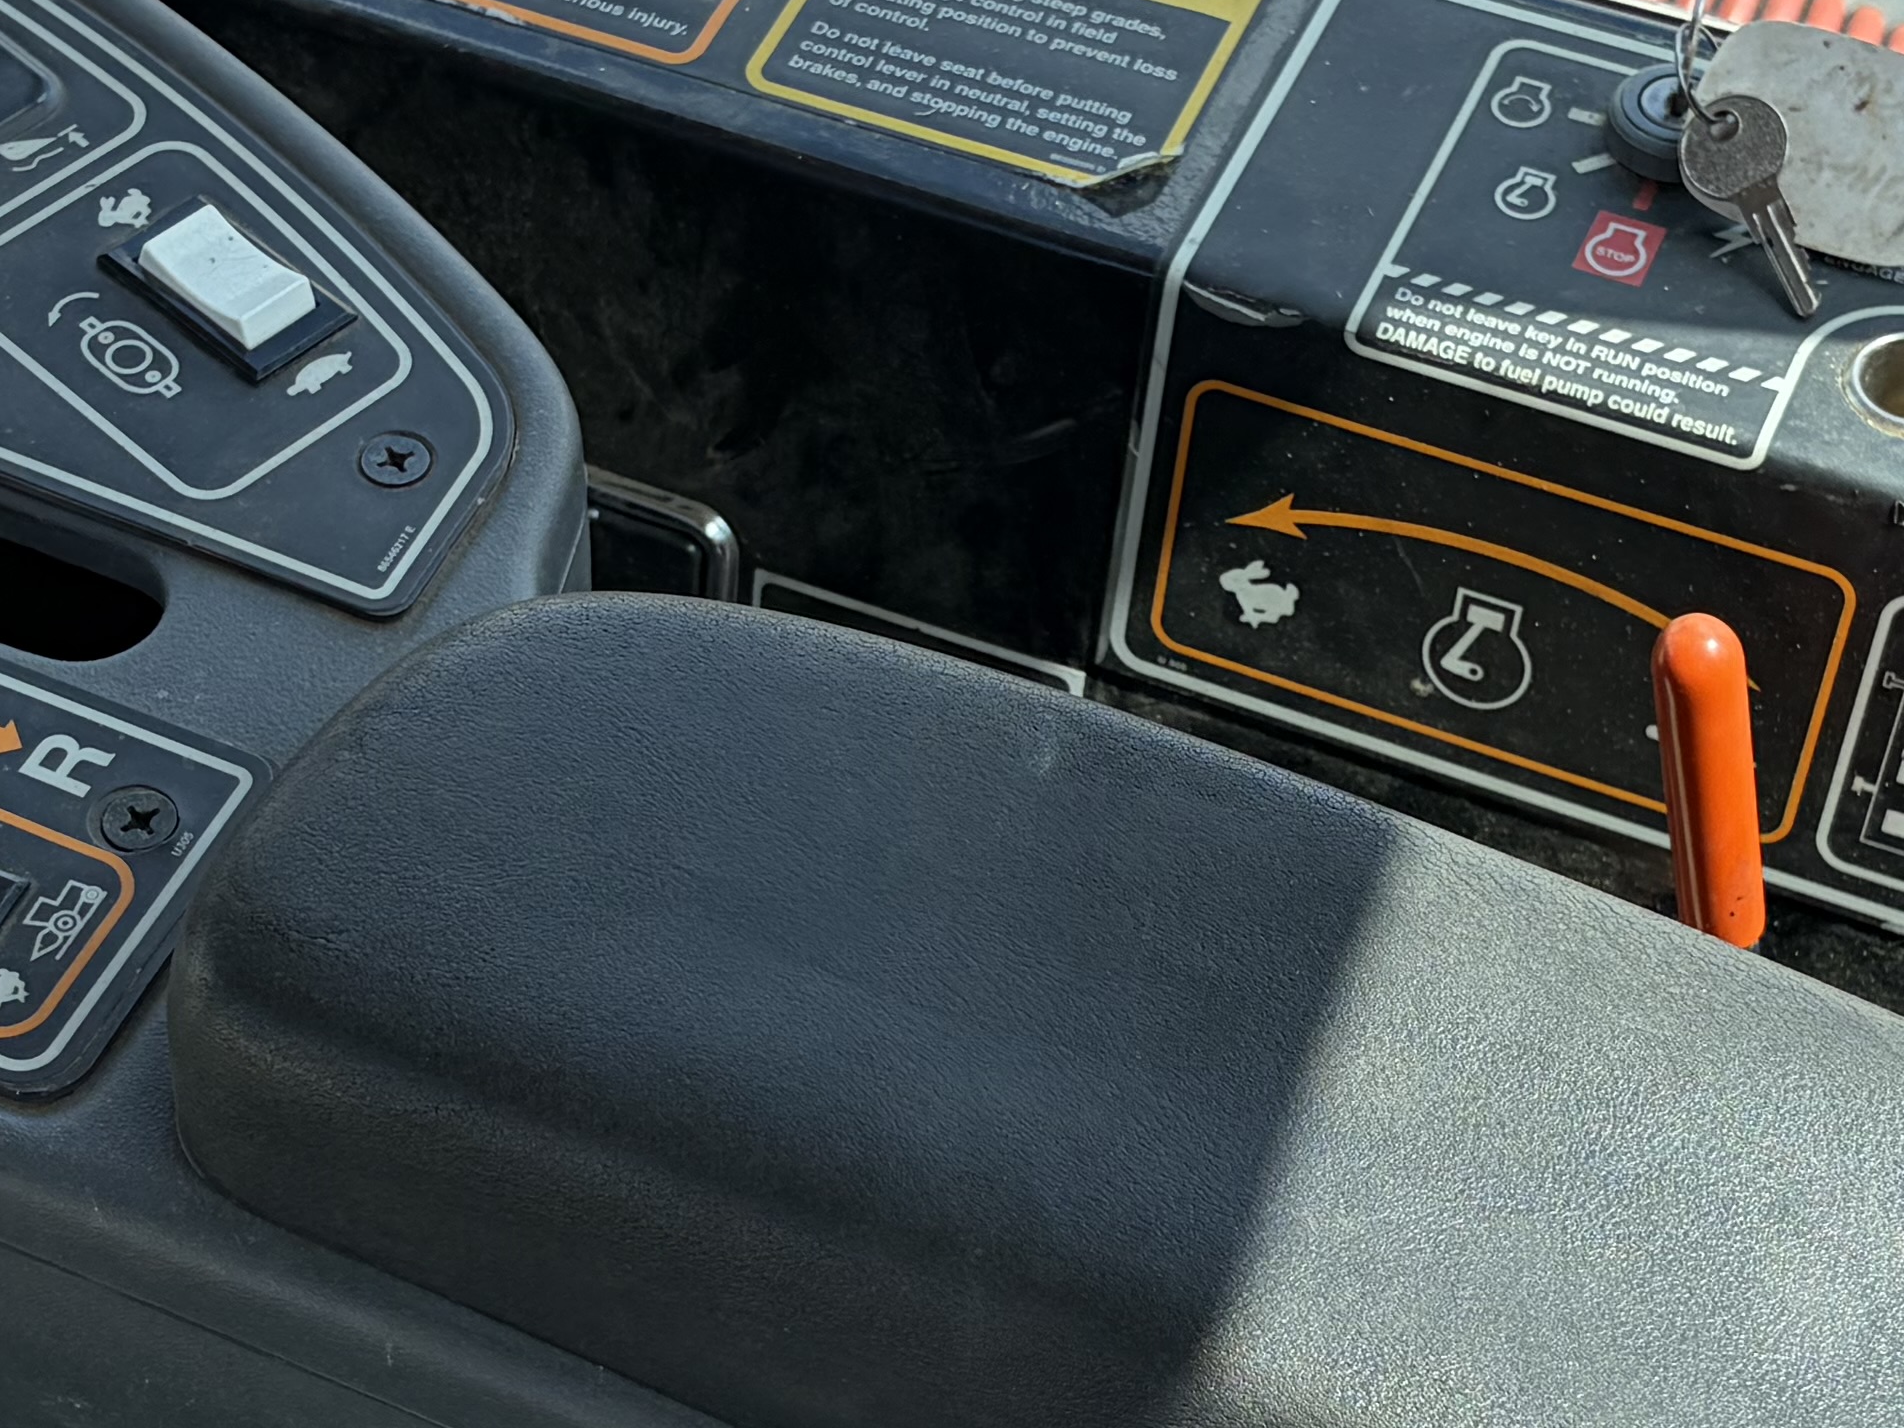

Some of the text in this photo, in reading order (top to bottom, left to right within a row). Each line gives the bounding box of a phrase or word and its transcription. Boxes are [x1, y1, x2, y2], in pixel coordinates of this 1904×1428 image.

[627, 7, 687, 36] injury.
[854, 2, 929, 32] control.
[936, 6, 1022, 37] position
[1025, 29, 1048, 44] to
[1049, 38, 1131, 68] prevent
[1133, 59, 1178, 81] loss
[1046, 15, 1067, 30] in
[1070, 22, 1118, 44] field
[1090, 10, 1166, 41] grades,
[788, 54, 1118, 160] brakes, and stopping the engine.
[800, 40, 1147, 147] control lever in neutral, setting the
[810, 21, 1132, 125] Do not leave seat before putting
[1596, 246, 1635, 263] STOP
[1386, 305, 1679, 405] when engine is NOT running.
[1395, 286, 1425, 306] Do
[1428, 298, 1464, 319] not
[1466, 308, 1521, 335] leave
[1524, 325, 1563, 349] key
[1591, 344, 1641, 371] RUN
[1641, 363, 1730, 397] position
[1375, 322, 1738, 446] DAMAGE to fuel pump could result.
[18, 733, 116, 798] R
